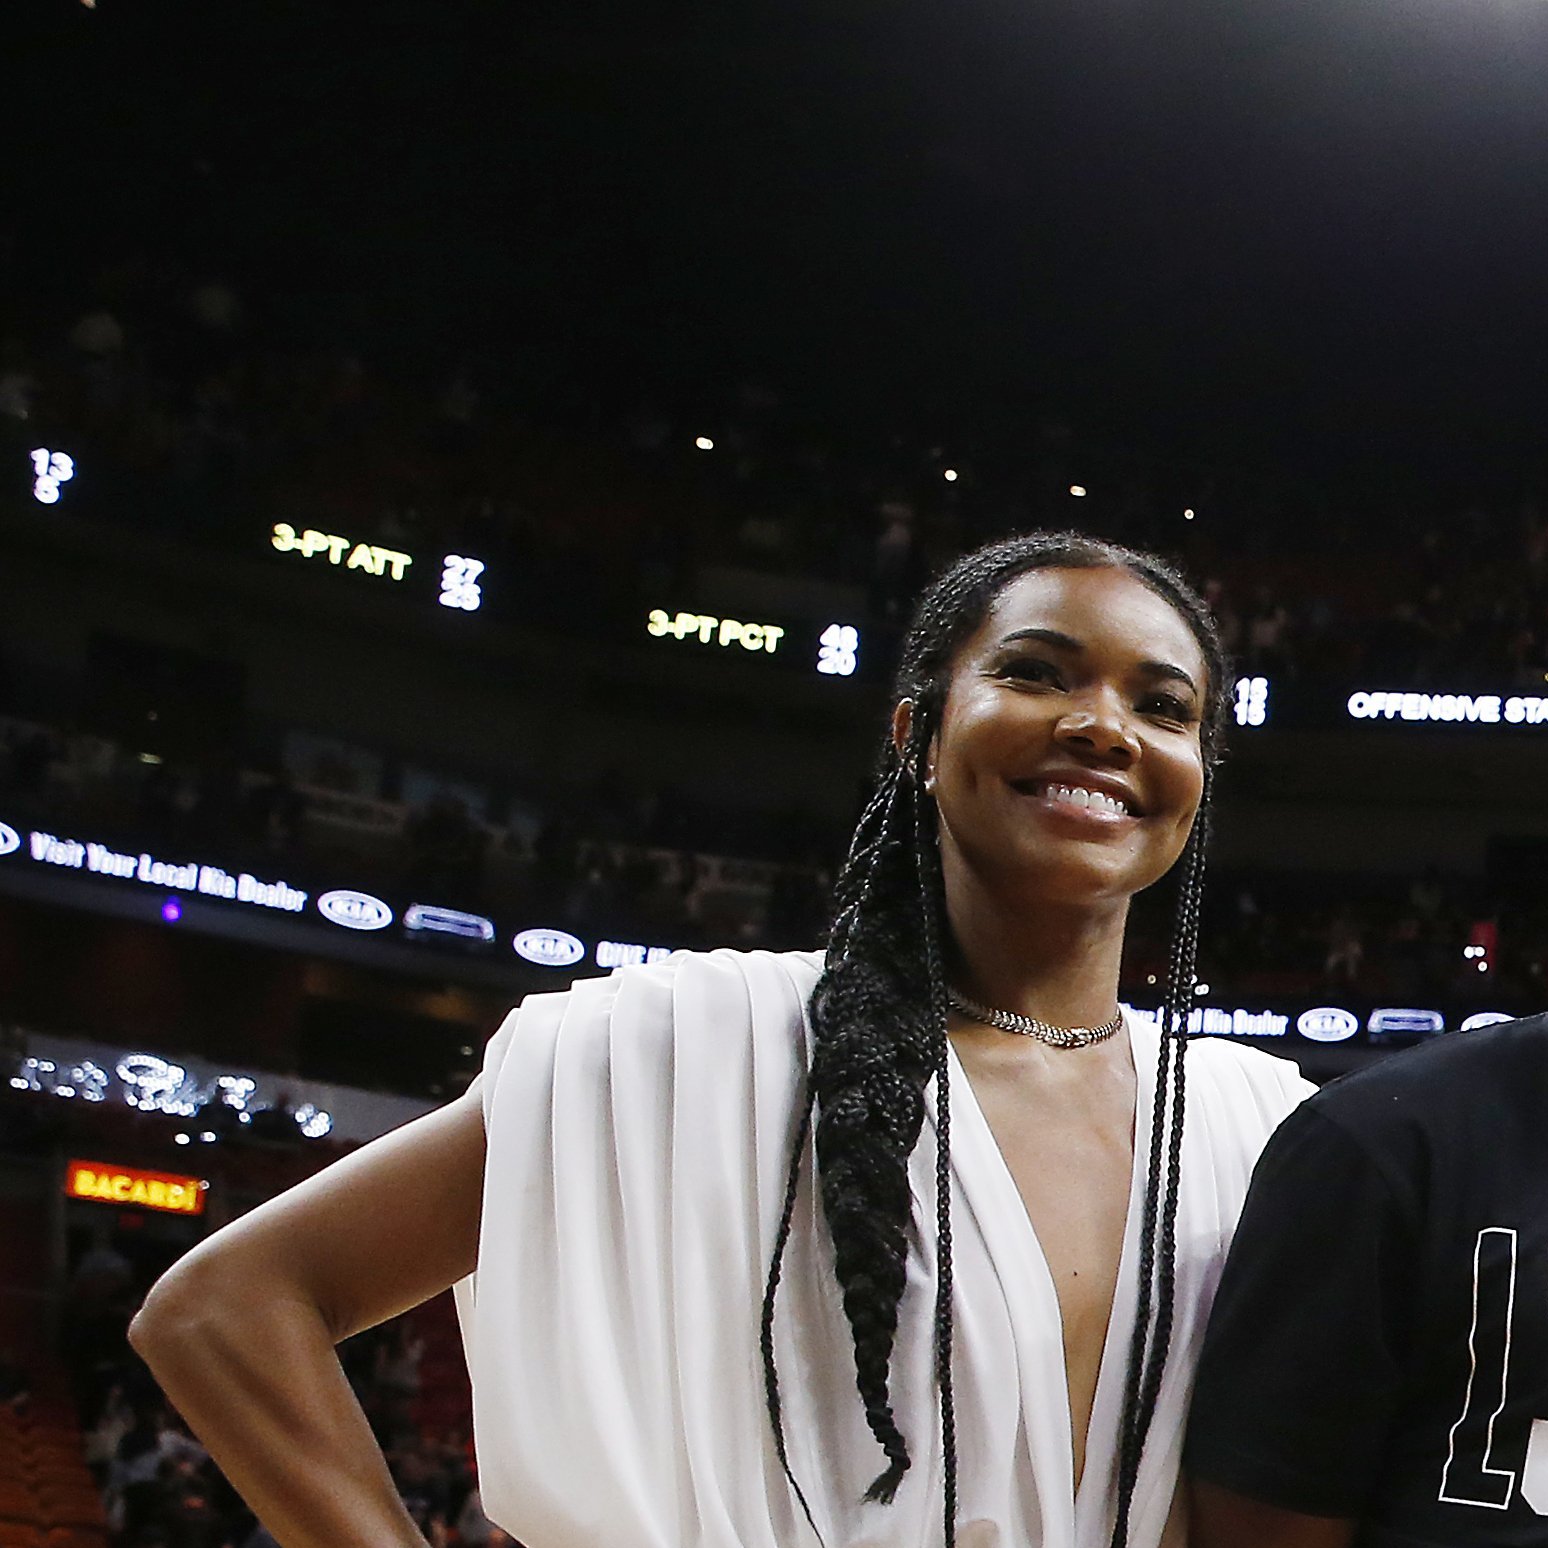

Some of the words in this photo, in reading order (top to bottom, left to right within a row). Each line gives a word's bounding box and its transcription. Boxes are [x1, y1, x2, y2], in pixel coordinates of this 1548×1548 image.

[30, 447, 75, 482] 13
[271, 523, 350, 565] 3-PT
[347, 543, 412, 581] ATT
[647, 609, 718, 644] 3-PT
[718, 619, 785, 654] PCT
[1347, 691, 1501, 723] OFFENSIVE
[137, 853, 198, 891] Local
[237, 873, 308, 913] Dealer
